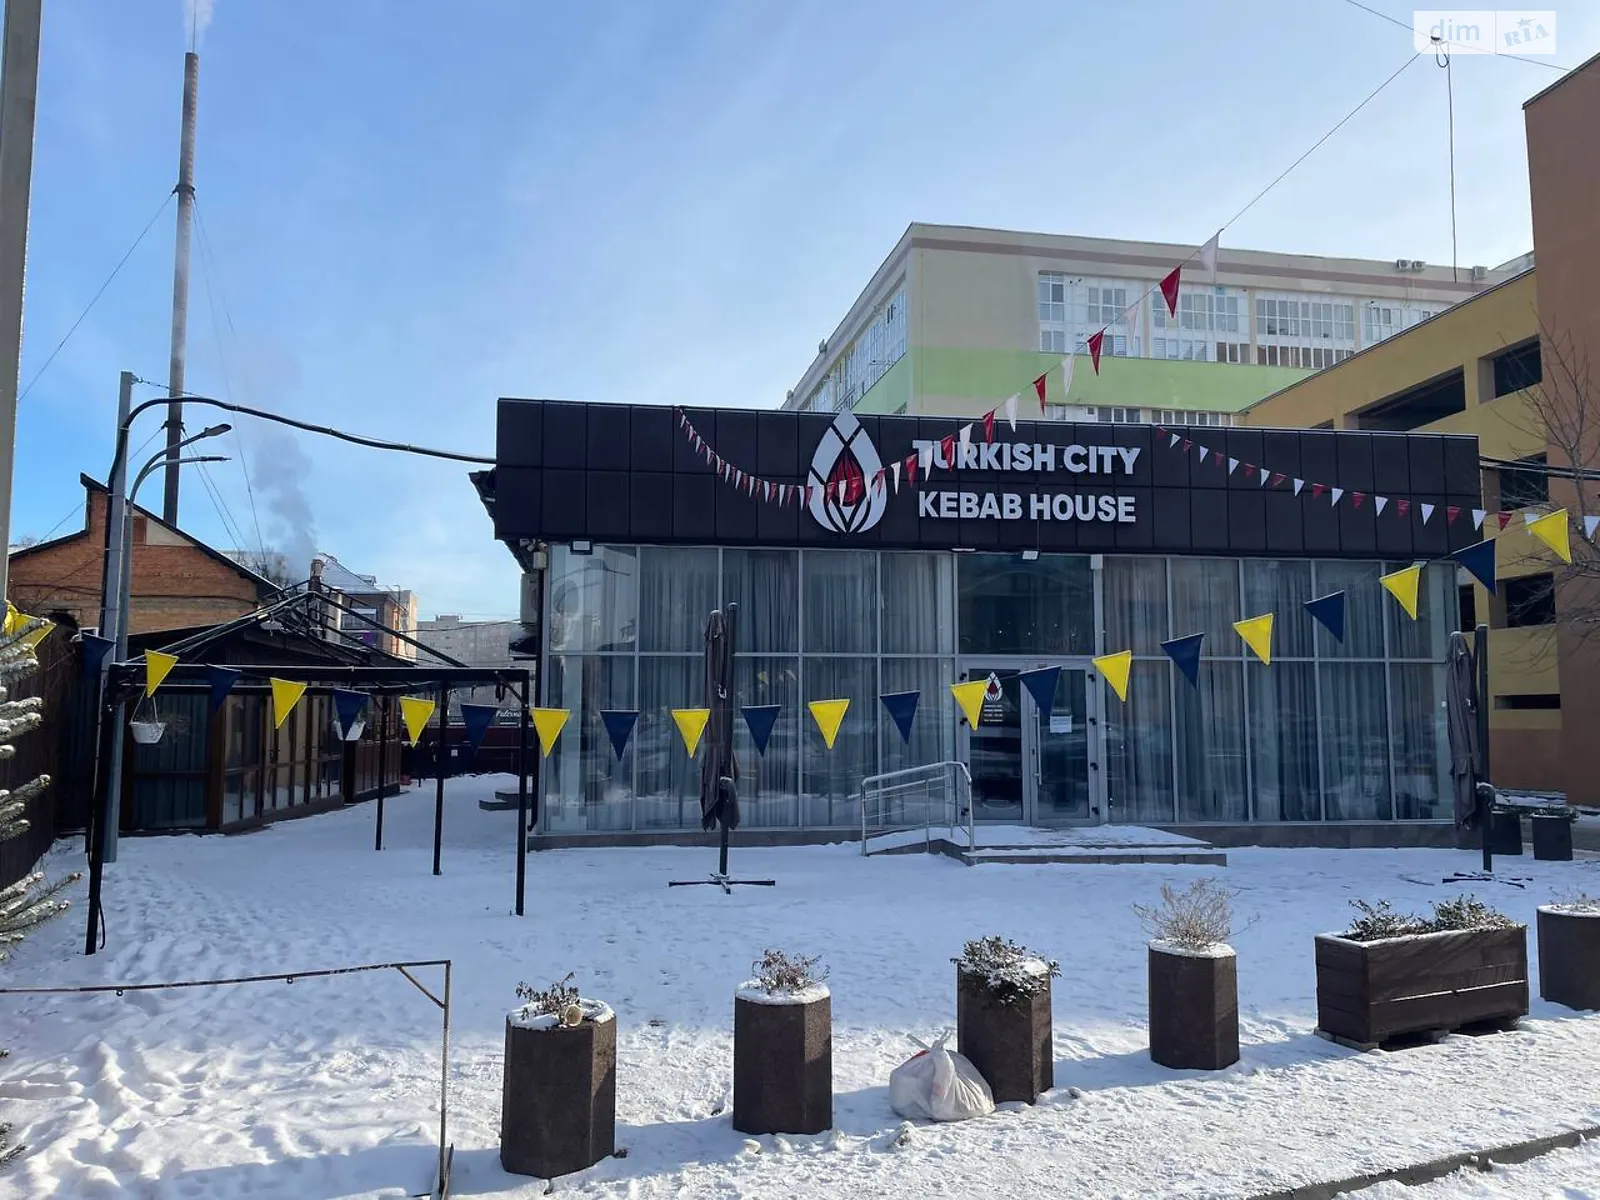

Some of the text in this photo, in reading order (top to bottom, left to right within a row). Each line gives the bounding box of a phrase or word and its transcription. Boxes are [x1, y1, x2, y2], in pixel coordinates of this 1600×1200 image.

[912, 440, 1140, 476] TURKISH CITY
[918, 491, 1136, 523] KEBAB HOUSE
